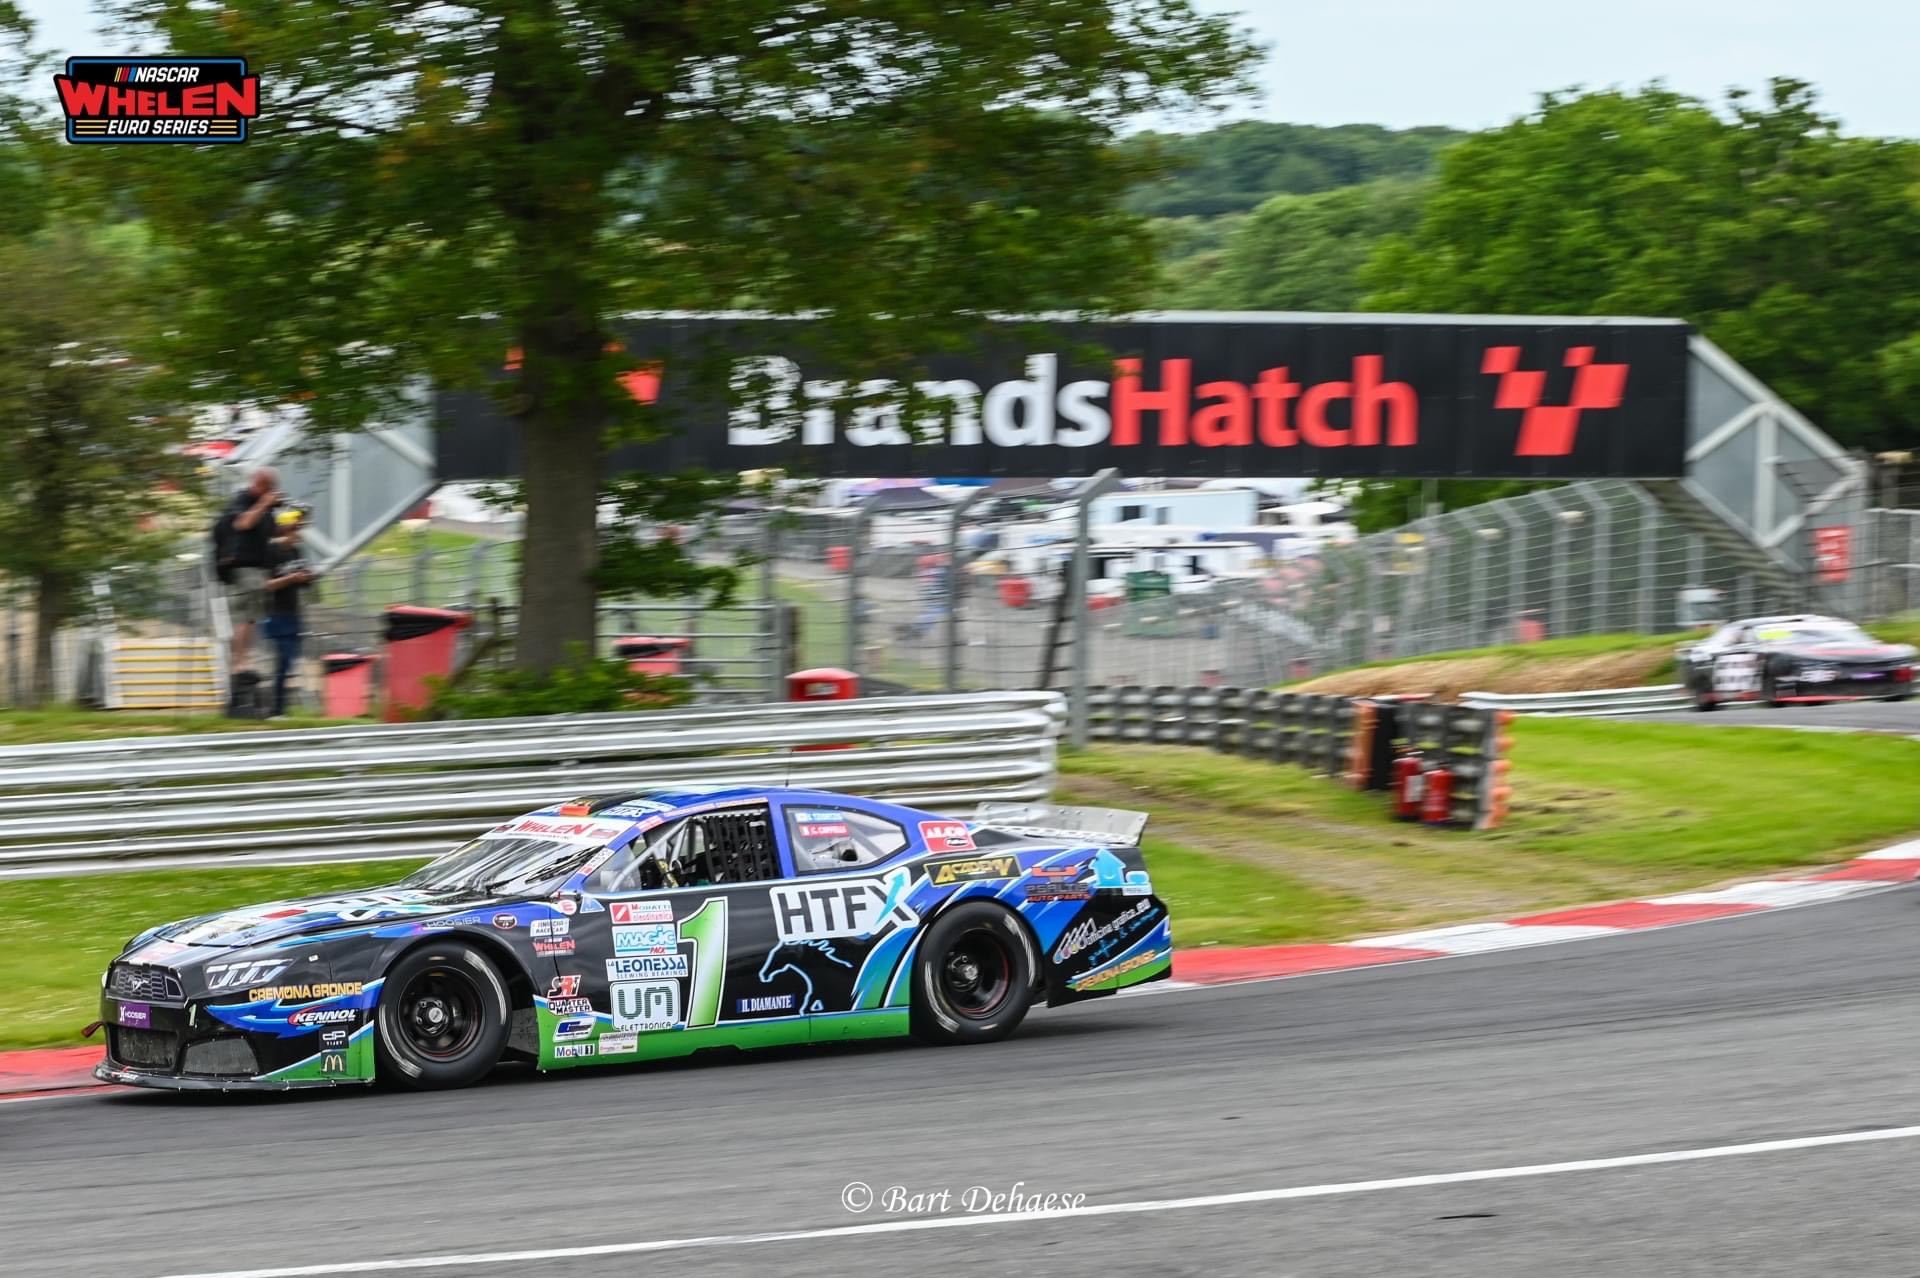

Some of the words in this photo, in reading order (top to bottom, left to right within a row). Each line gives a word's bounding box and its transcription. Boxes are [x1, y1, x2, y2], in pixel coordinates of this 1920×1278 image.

[514, 820, 594, 835] WHELEN
[776, 872, 914, 935] HTFX
[426, 916, 481, 929] HOOSIER
[615, 956, 687, 974] LEONESSA
[677, 896, 728, 1030] 1
[616, 972, 649, 980] SLEWING
[651, 968, 689, 978] BEARINGS
[249, 984, 312, 1002] CREMONA
[311, 981, 362, 999] GRONDE
[549, 999, 588, 1011] QUARTER
[556, 1004, 590, 1015] MASTER
[750, 994, 792, 1011] DIAMANTE
[293, 1009, 357, 1023] KENNOL
[620, 1020, 672, 1032] ELETTRONICA
[556, 1045, 583, 1058] Mobil
